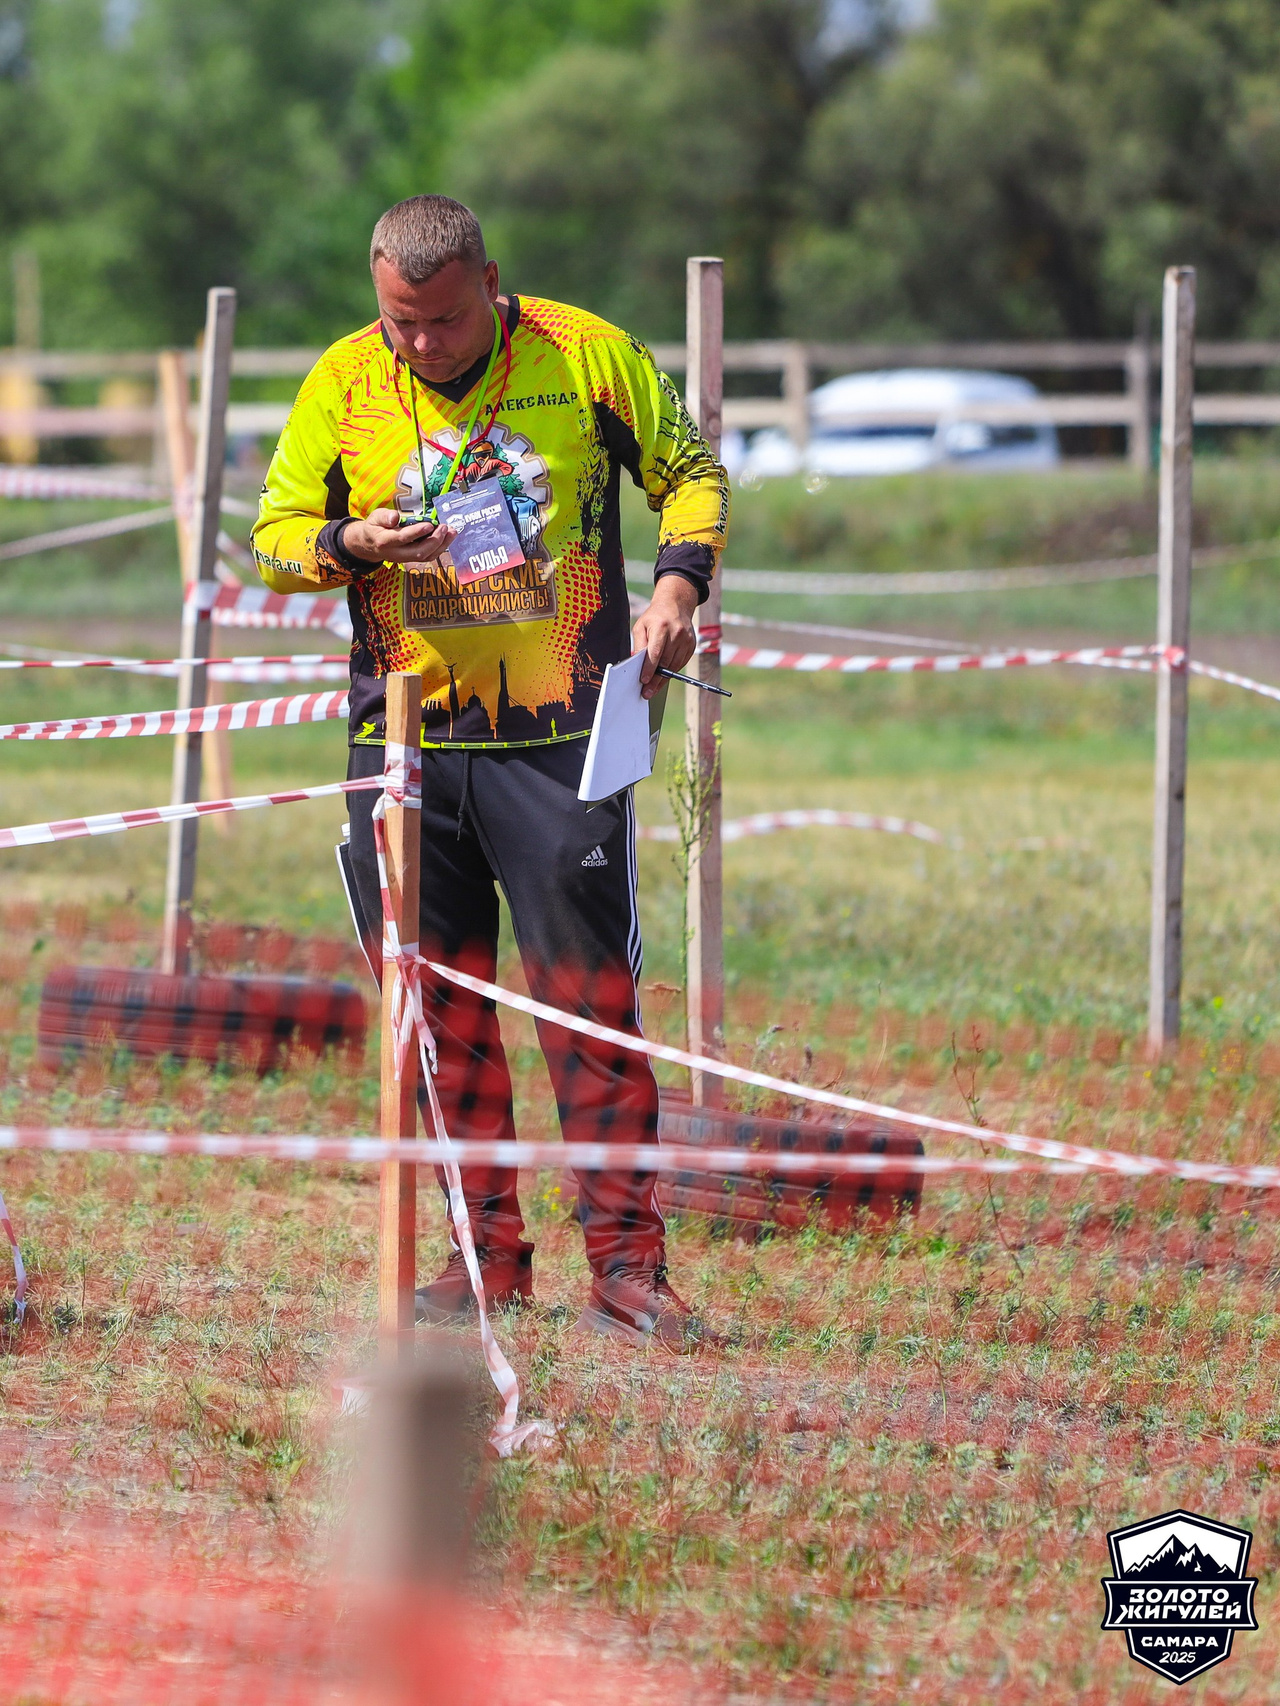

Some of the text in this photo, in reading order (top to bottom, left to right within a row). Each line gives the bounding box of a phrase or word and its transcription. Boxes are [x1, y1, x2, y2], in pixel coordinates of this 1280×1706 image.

[485, 391, 578, 416] АЛЕКСАНДР
[468, 545, 509, 574] СУДЬЯ
[410, 588, 549, 620] КВАДРОЦИКЛИСТЫ
[581, 858, 608, 867] adidas
